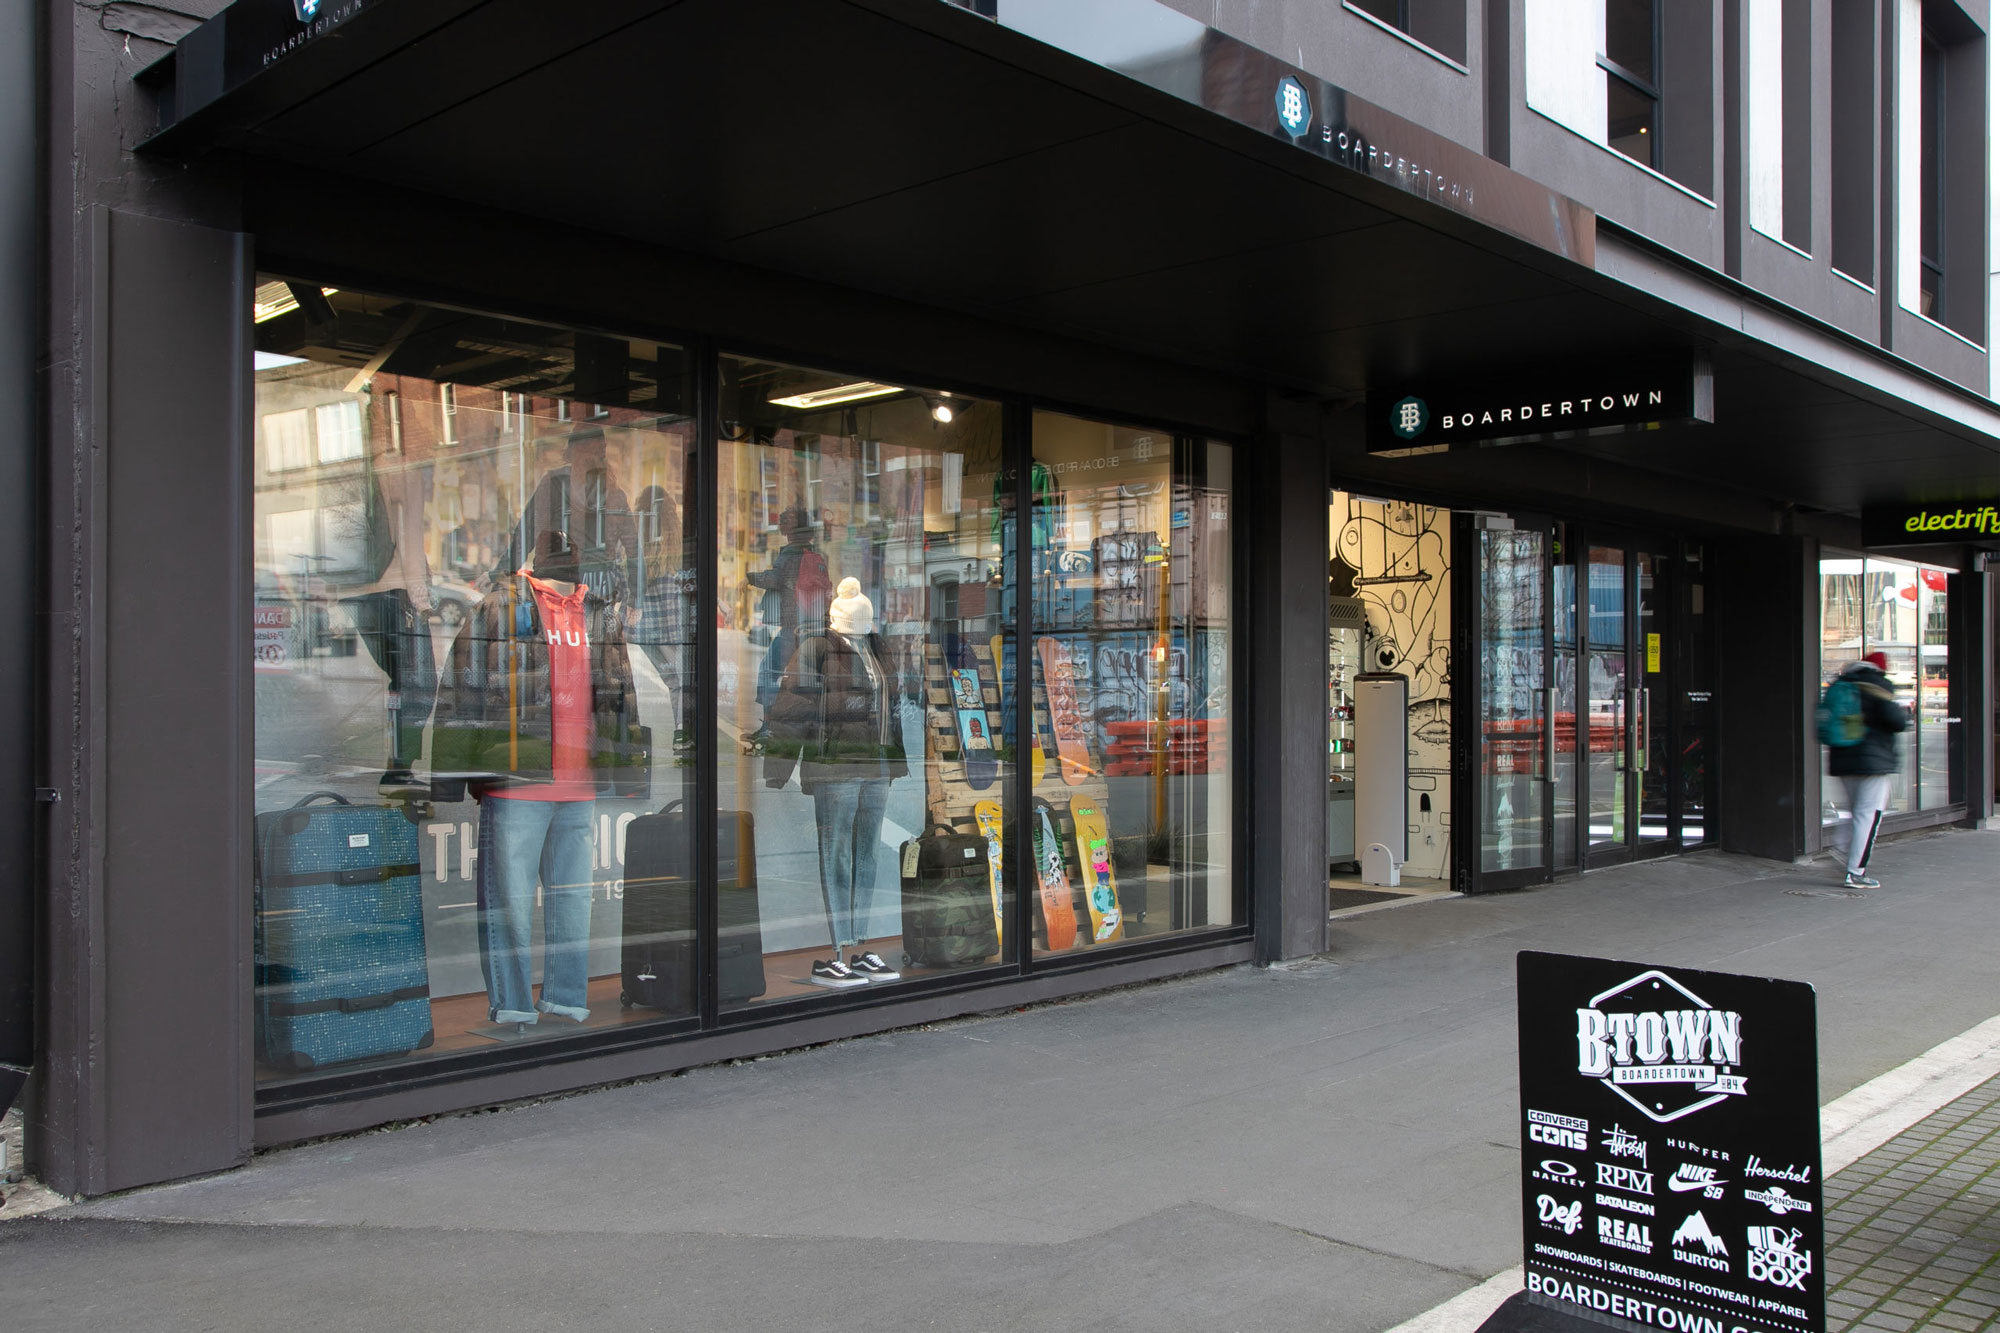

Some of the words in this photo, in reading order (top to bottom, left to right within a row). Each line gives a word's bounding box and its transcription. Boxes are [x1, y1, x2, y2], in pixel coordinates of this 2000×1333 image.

[1321, 125, 1475, 205] BOARDERTOWN
[1442, 390, 1663, 430] BOARDERTOWN
[1905, 507, 2000, 534] electrify
[1621, 1067, 1706, 1081] BOARDERTOWN
[1530, 1111, 1587, 1130] CONVERSE
[1529, 1123, 1587, 1151] CONS
[1666, 1138, 1730, 1161] HUFFER
[1532, 1170, 1586, 1188] OAKLEY
[1595, 1162, 1655, 1195] RPM
[1676, 1162, 1717, 1182] NIKE
[1744, 1154, 1811, 1183] Herschel
[1595, 1193, 1656, 1217] BATALEON
[1703, 1185, 1725, 1200] SB
[1747, 1191, 1808, 1210] INDEPENDENT
[1598, 1215, 1654, 1248] REAL
[1599, 1235, 1651, 1254] SKATEBOARDS
[1673, 1249, 1730, 1273] BURTON
[1747, 1250, 1808, 1292] box
[1752, 1247, 1812, 1274] sand
[1534, 1243, 1603, 1268] SNOWBOARDS
[1609, 1261, 1682, 1288] SKATEBOARDS
[1688, 1281, 1751, 1305] FOOTWEAR
[1757, 1299, 1810, 1321] APPAREL
[1527, 1271, 1764, 1333] BOARDERTOWN
